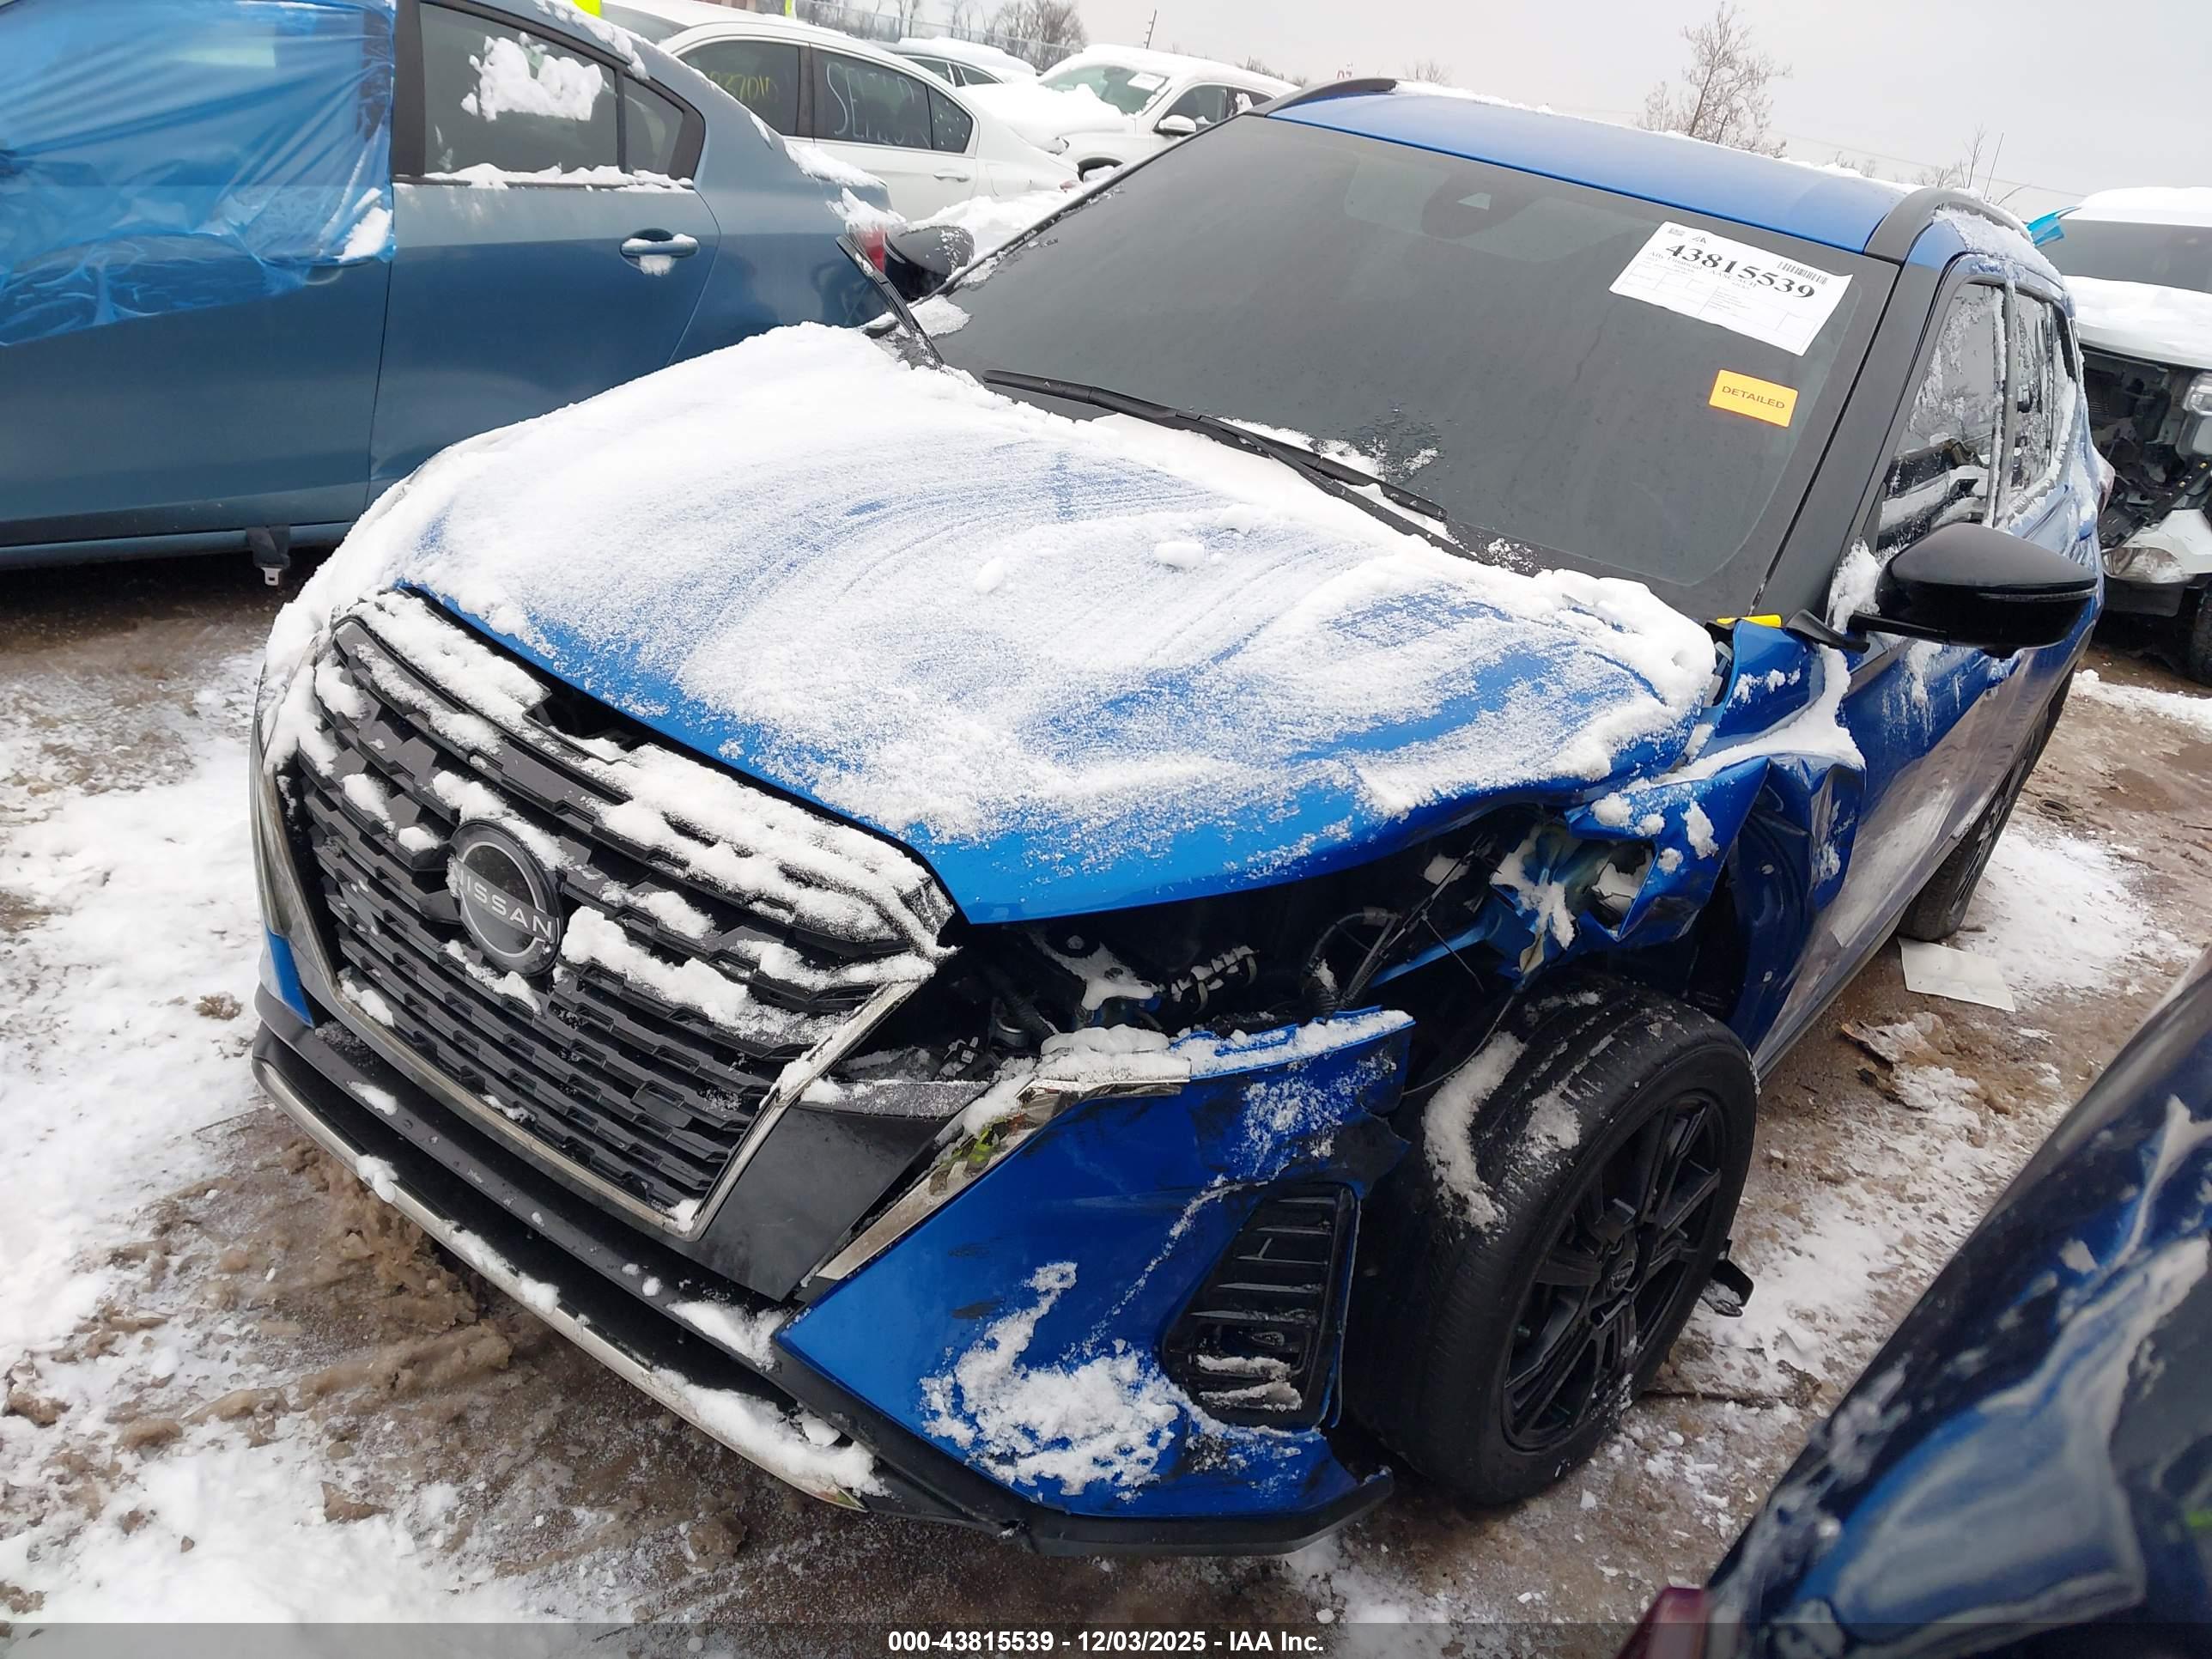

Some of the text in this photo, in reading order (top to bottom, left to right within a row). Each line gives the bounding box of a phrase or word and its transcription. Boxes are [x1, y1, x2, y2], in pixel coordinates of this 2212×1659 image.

[1665, 244, 1815, 299] 43815539
[1722, 386, 1785, 410] DETAILED
[454, 864, 552, 939] NISSAN
